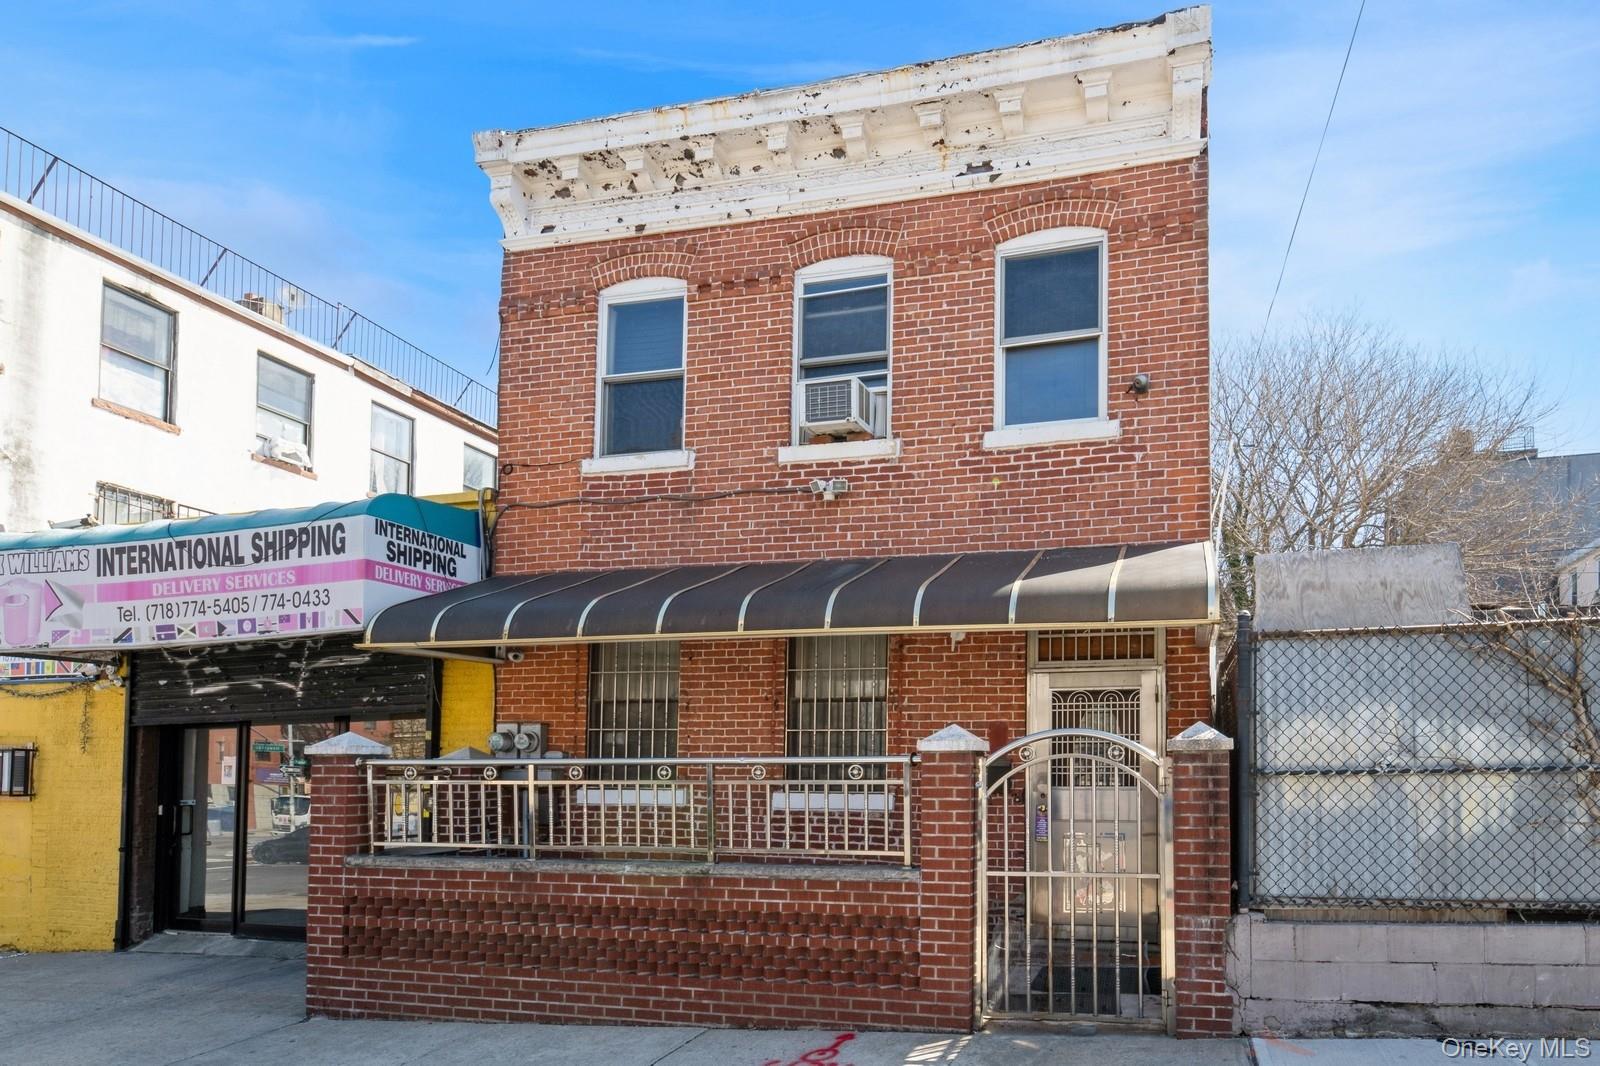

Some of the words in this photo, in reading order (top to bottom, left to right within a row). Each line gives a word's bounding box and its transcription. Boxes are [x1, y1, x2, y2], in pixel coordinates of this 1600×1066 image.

[96, 534, 245, 577] INTERNATIONAL
[251, 522, 346, 563] SHIPPING
[375, 518, 467, 559] INTERNATIONAL
[8, 549, 89, 574] WILLIAMS
[386, 540, 457, 578] SHIPPING
[152, 577, 221, 597] DELIVERY
[225, 570, 296, 591] SERVICES
[375, 564, 423, 589] DELIVERY
[117, 605, 140, 622] Tel.
